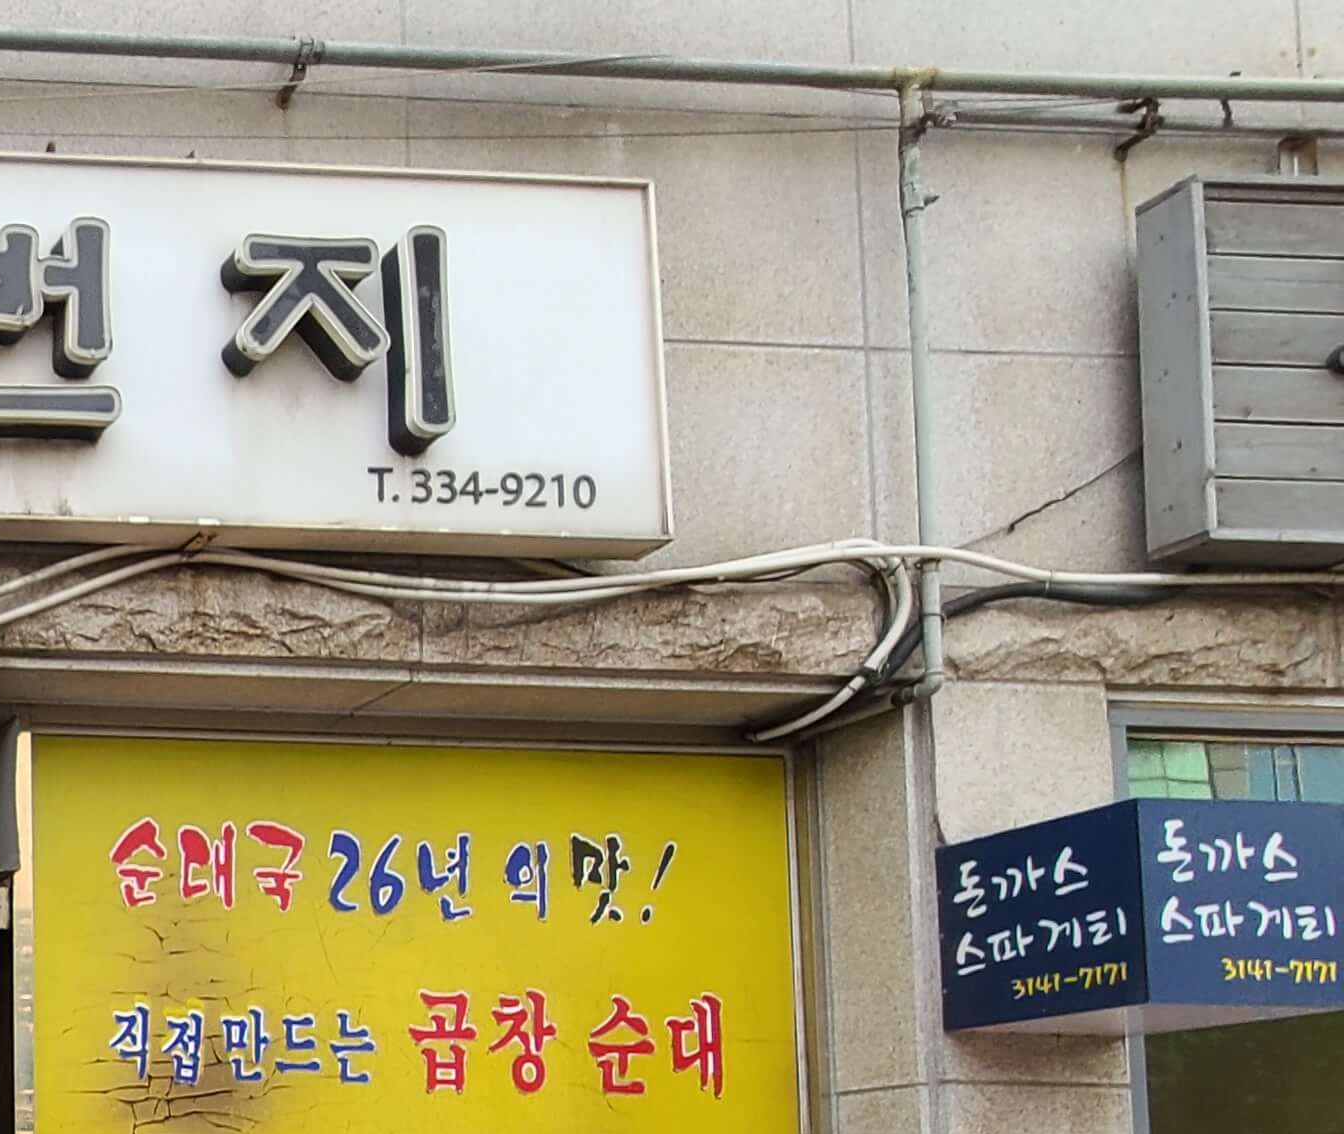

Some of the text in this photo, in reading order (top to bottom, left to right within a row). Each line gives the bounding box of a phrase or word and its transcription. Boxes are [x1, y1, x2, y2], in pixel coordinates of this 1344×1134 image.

[368, 467, 597, 509] T. 334-9210
[111, 817, 306, 912] 순대국
[570, 834, 675, 926] 맛!
[953, 845, 1089, 918] 돈까스
[1157, 819, 1299, 883] 돈까스
[955, 906, 1128, 977] 스파게티
[1160, 895, 1337, 944] 스파게티
[1011, 961, 1129, 1000] 3141-7171
[1220, 956, 1337, 984] 3141-7171
[408, 989, 556, 1096] 곱창
[587, 993, 724, 1100] 순대
